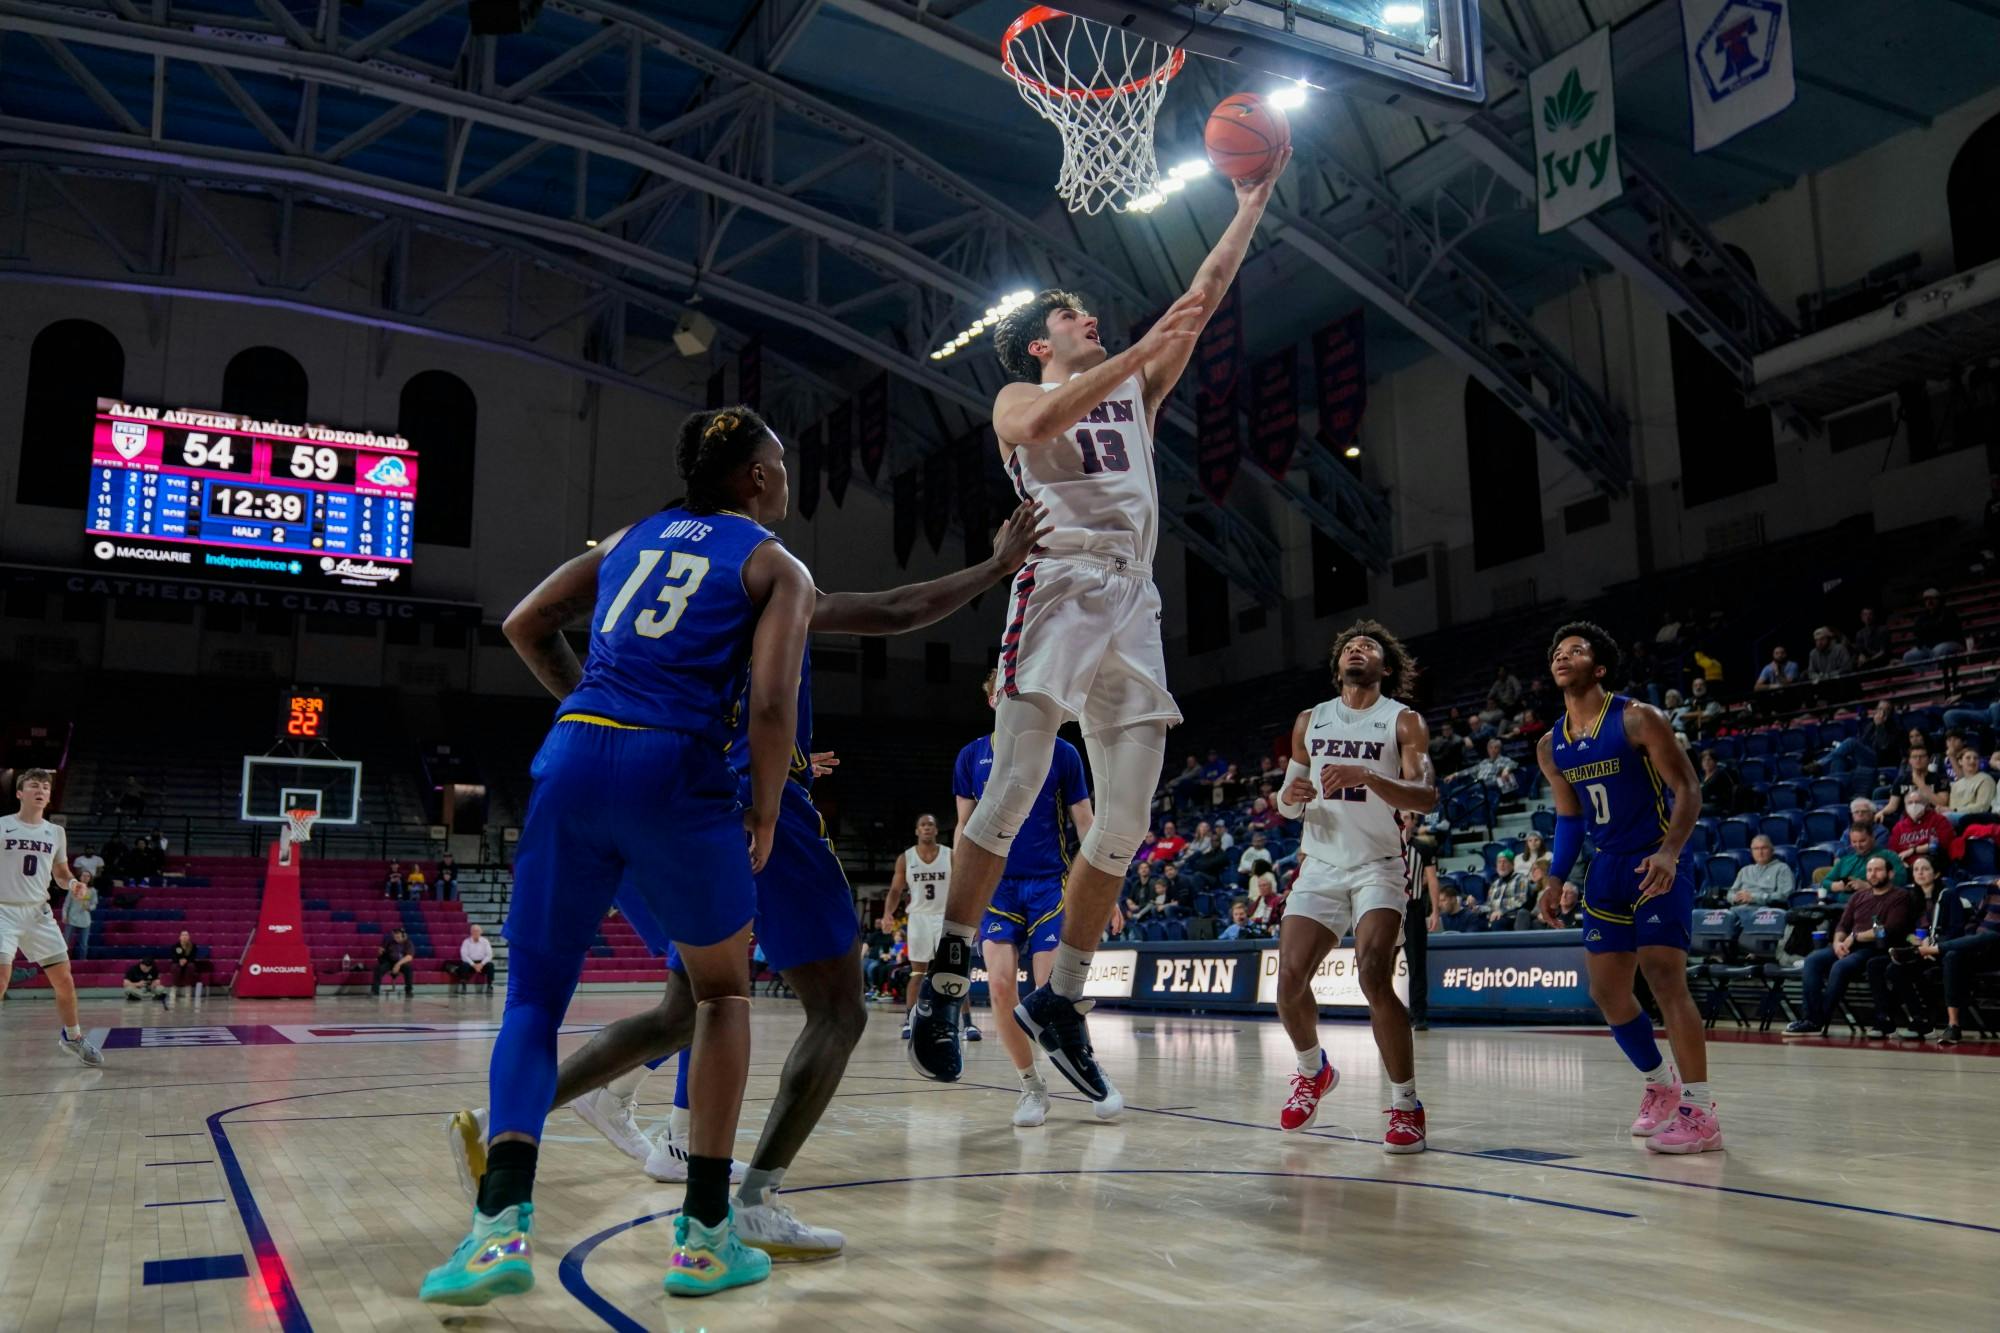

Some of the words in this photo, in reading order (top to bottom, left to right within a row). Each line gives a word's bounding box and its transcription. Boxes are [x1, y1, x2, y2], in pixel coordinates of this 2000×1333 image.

[1543, 133, 1612, 199] Ivy
[109, 403, 159, 421] ALAN
[162, 409, 237, 430] AUFZIEN
[240, 419, 303, 438] FAMILY
[306, 426, 409, 450] VIDEOBOARD
[182, 432, 235, 470] 54
[1075, 428, 1131, 474] 13
[289, 444, 339, 481] 59
[143, 473, 158, 484] 17
[191, 480, 200, 491] 3
[102, 481, 110, 492] 3
[129, 485, 136, 495] 1
[97, 494, 111, 505] 11
[190, 495, 199, 506] 2
[216, 488, 302, 521] 12:39
[315, 493, 324, 504] 2
[388, 499, 395, 509] 1
[314, 508, 323, 519] 4
[362, 509, 371, 519] 4
[95, 519, 110, 530] 22
[141, 523, 150, 534] 4
[232, 526, 262, 538] HALF
[272, 527, 284, 543] 2
[387, 523, 393, 533] 1
[658, 519, 713, 542] DAVIS
[386, 535, 392, 545] 1
[401, 536, 409, 546] 7
[116, 546, 191, 563] MACQUARIE
[358, 544, 372, 555] 14
[205, 553, 287, 571] Independence
[336, 558, 400, 582] Academy
[66, 576, 270, 606] CATHEDRAL
[282, 594, 414, 619] CLASSIC
[600, 549, 711, 640] 13
[291, 697, 323, 712] 12:39
[288, 711, 318, 735] 22
[1311, 738, 1385, 761] PENN
[1586, 783, 1611, 825] 0
[4, 839, 54, 854] PENN
[22, 854, 38, 877] 0
[912, 871, 947, 883] PENN
[924, 883, 936, 901] 3
[262, 966, 307, 974] MACQUARIE
[1152, 958, 1237, 994] PENN
[1443, 967, 1578, 991] #FightOnPenn
